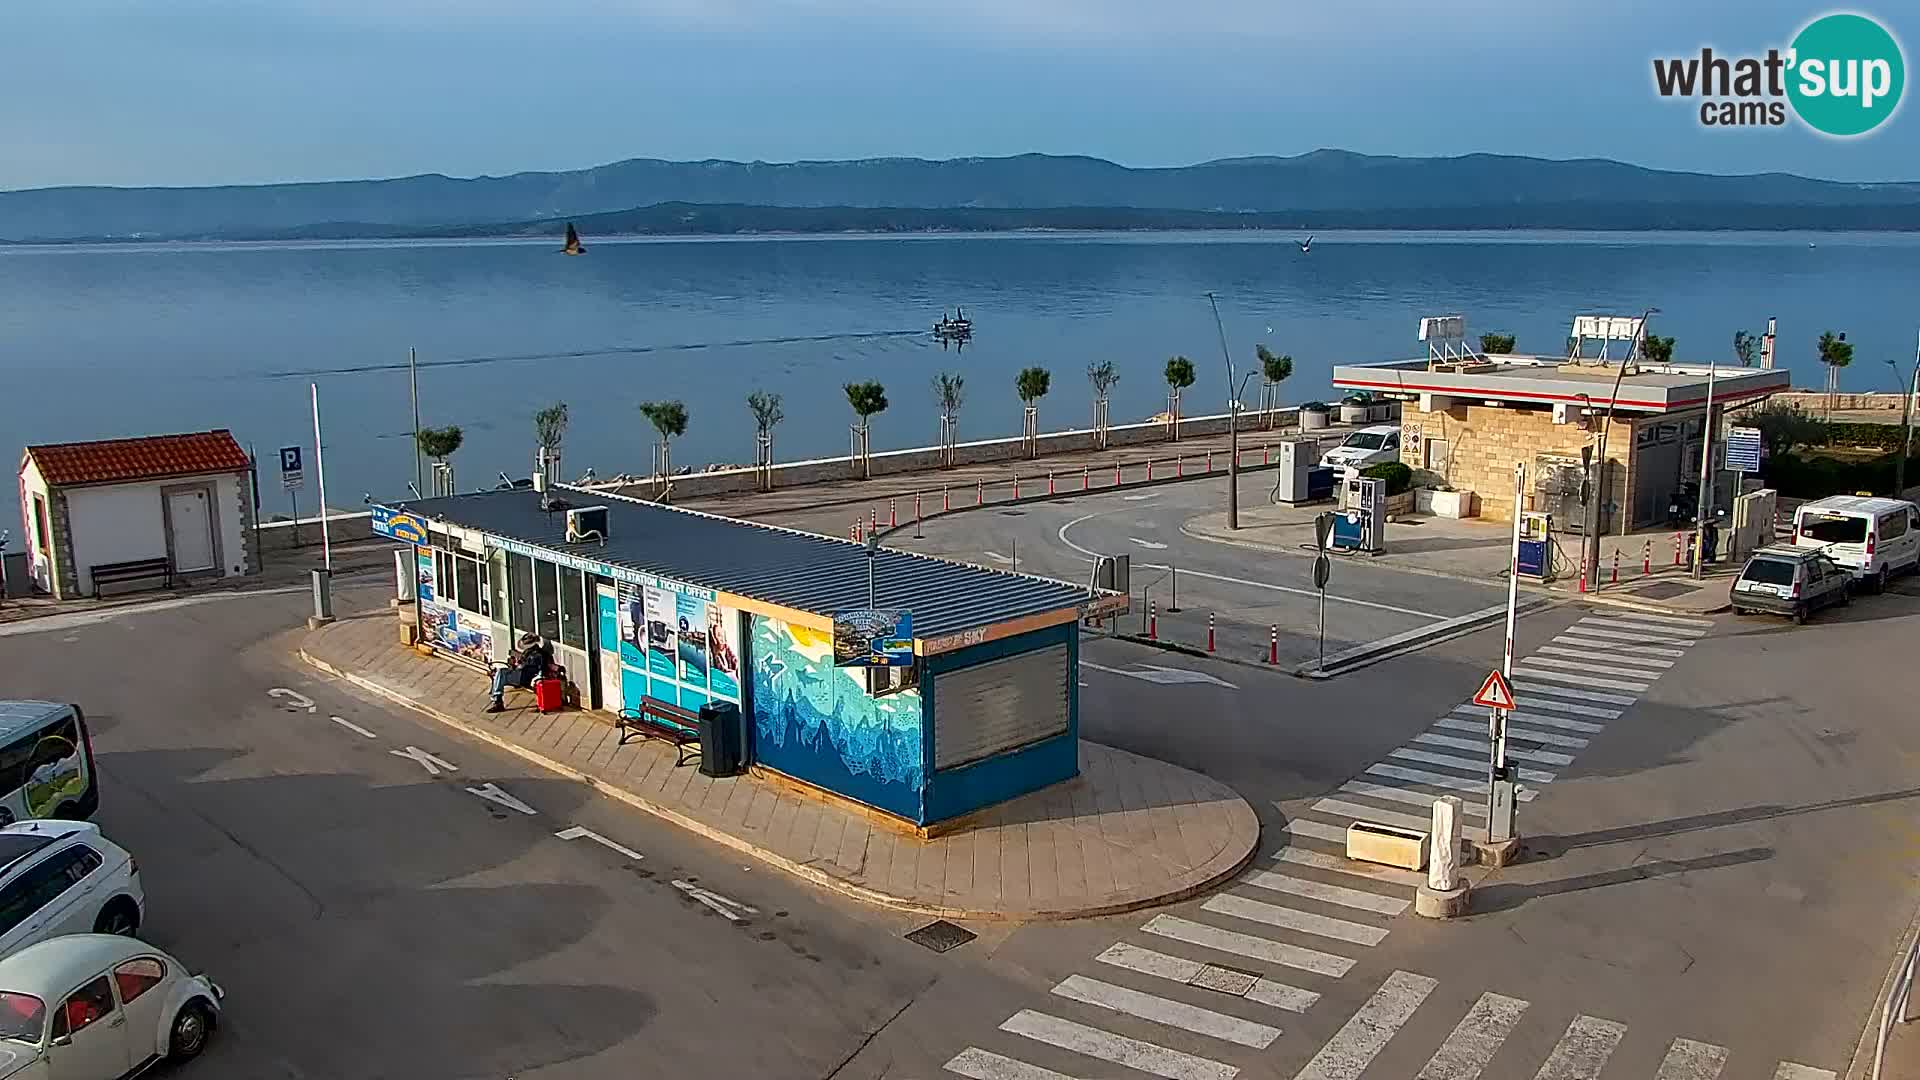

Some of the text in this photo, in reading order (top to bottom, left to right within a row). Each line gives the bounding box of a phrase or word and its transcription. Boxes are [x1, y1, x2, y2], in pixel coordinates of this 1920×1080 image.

[285, 450, 297, 469] P
[571, 556, 602, 575] POSTAJA
[611, 567, 626, 580] BUS
[626, 570, 658, 587] STATION
[660, 579, 685, 594] TICKET
[685, 584, 712, 601] OFFICE
